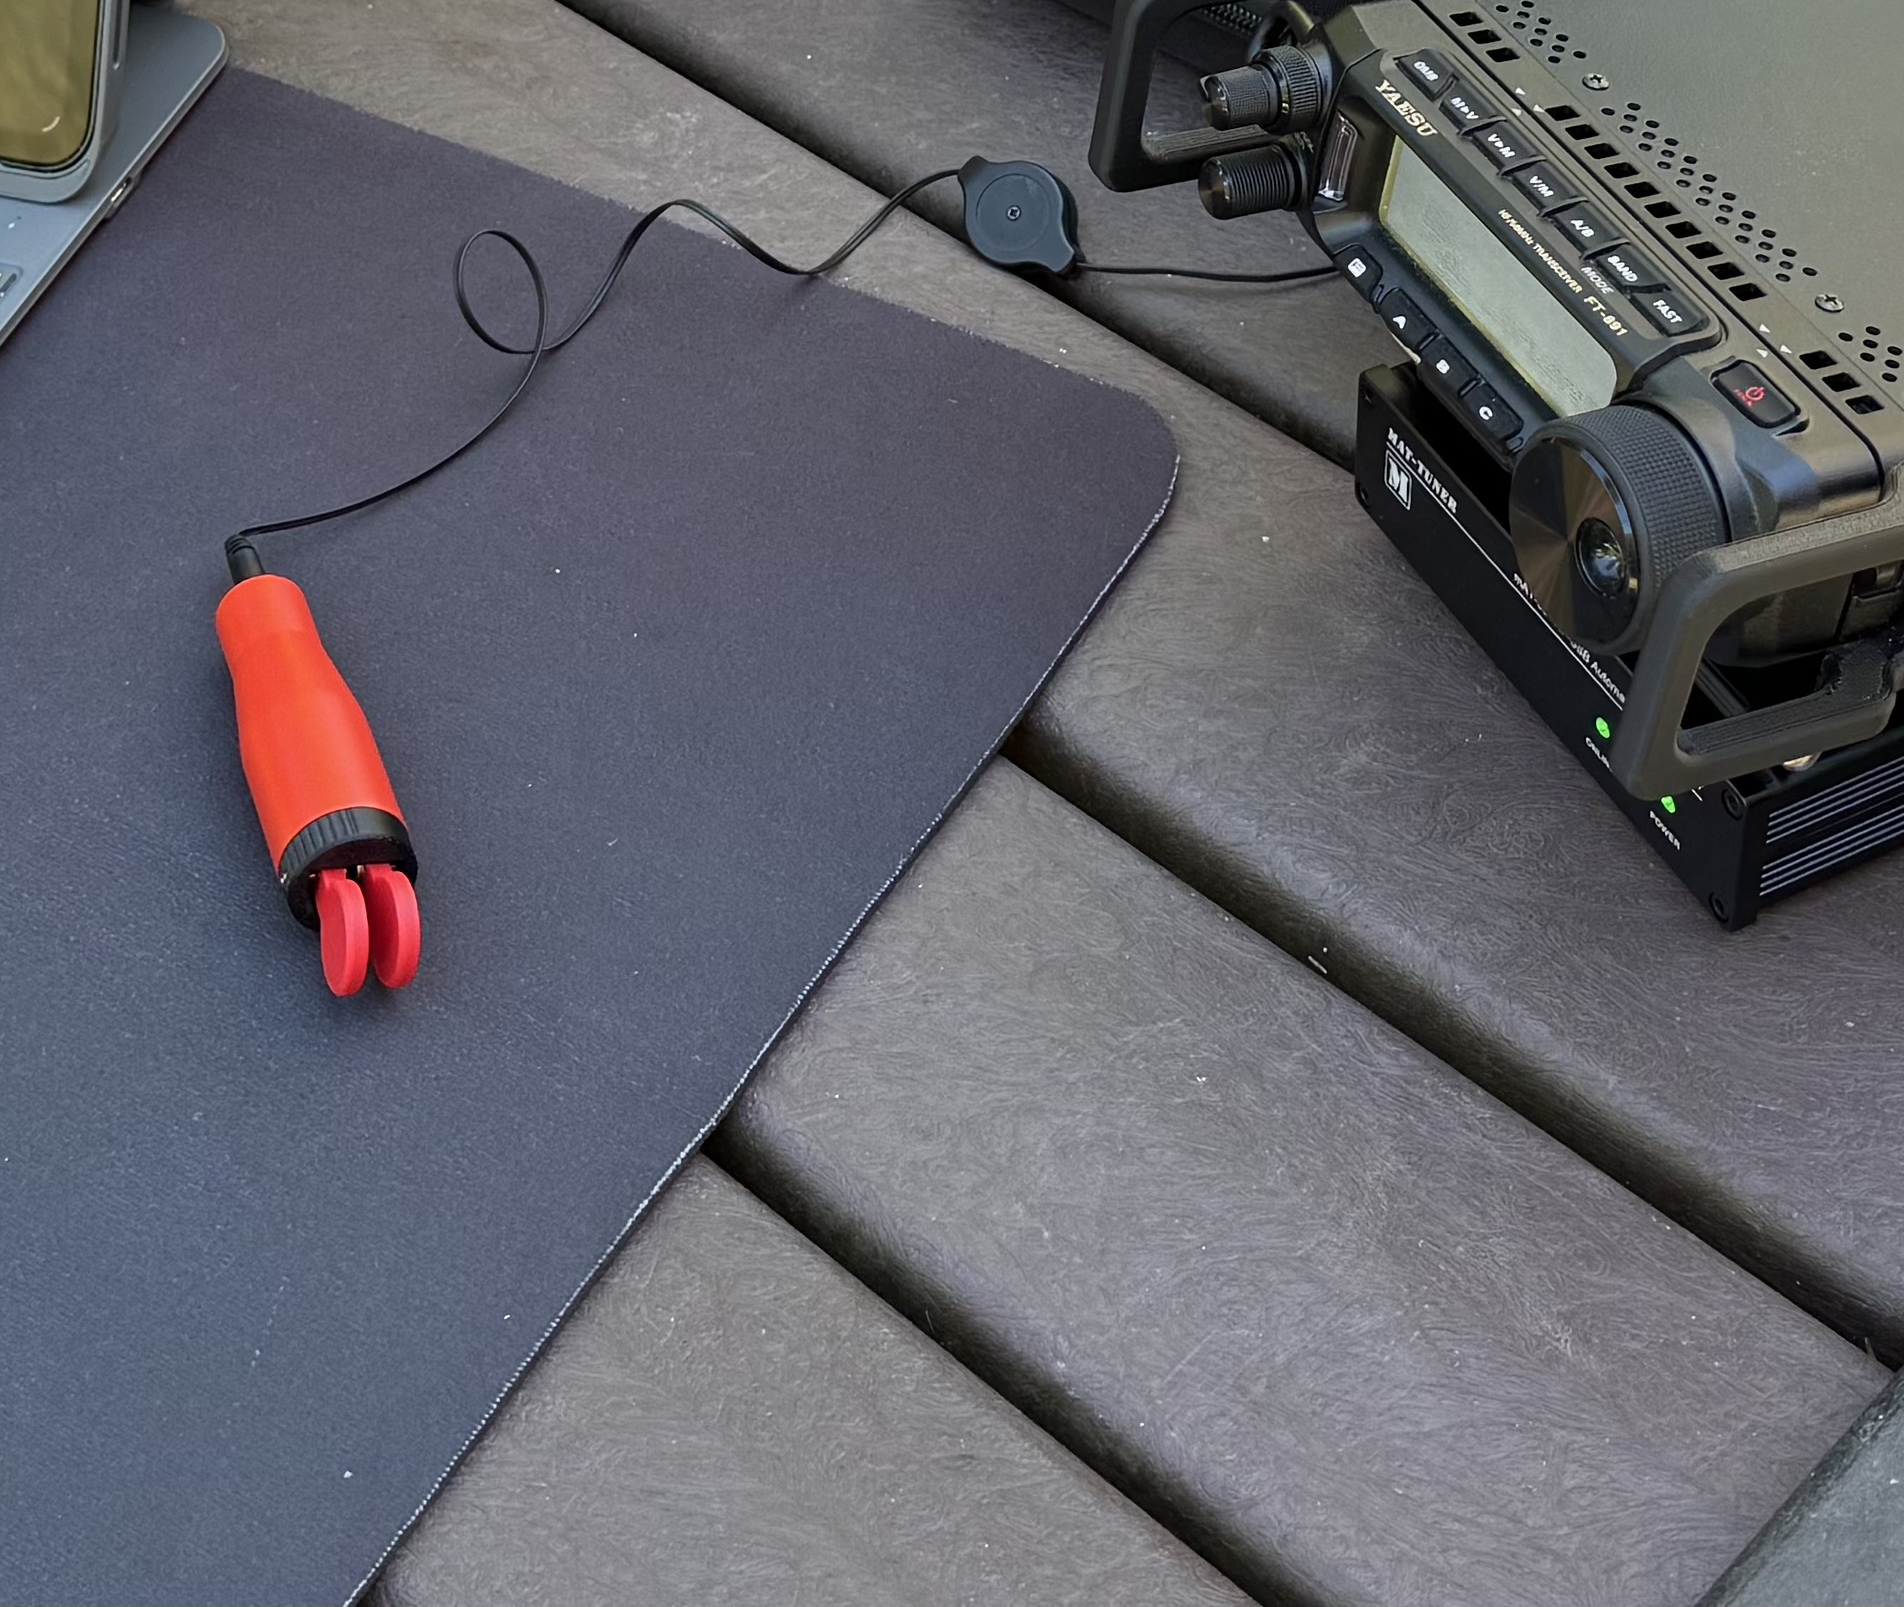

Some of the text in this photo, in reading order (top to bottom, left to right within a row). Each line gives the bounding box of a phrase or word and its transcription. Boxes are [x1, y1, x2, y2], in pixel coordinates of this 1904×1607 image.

[1375, 79, 1439, 137] YAESU
[1580, 266, 1615, 295] MODE
[1607, 255, 1639, 283] BAND
[1652, 298, 1684, 324] FAST
[1387, 427, 1459, 514] MAT-TUNER
[1590, 661, 1626, 704] Automa
[1649, 810, 1682, 851] POWER
